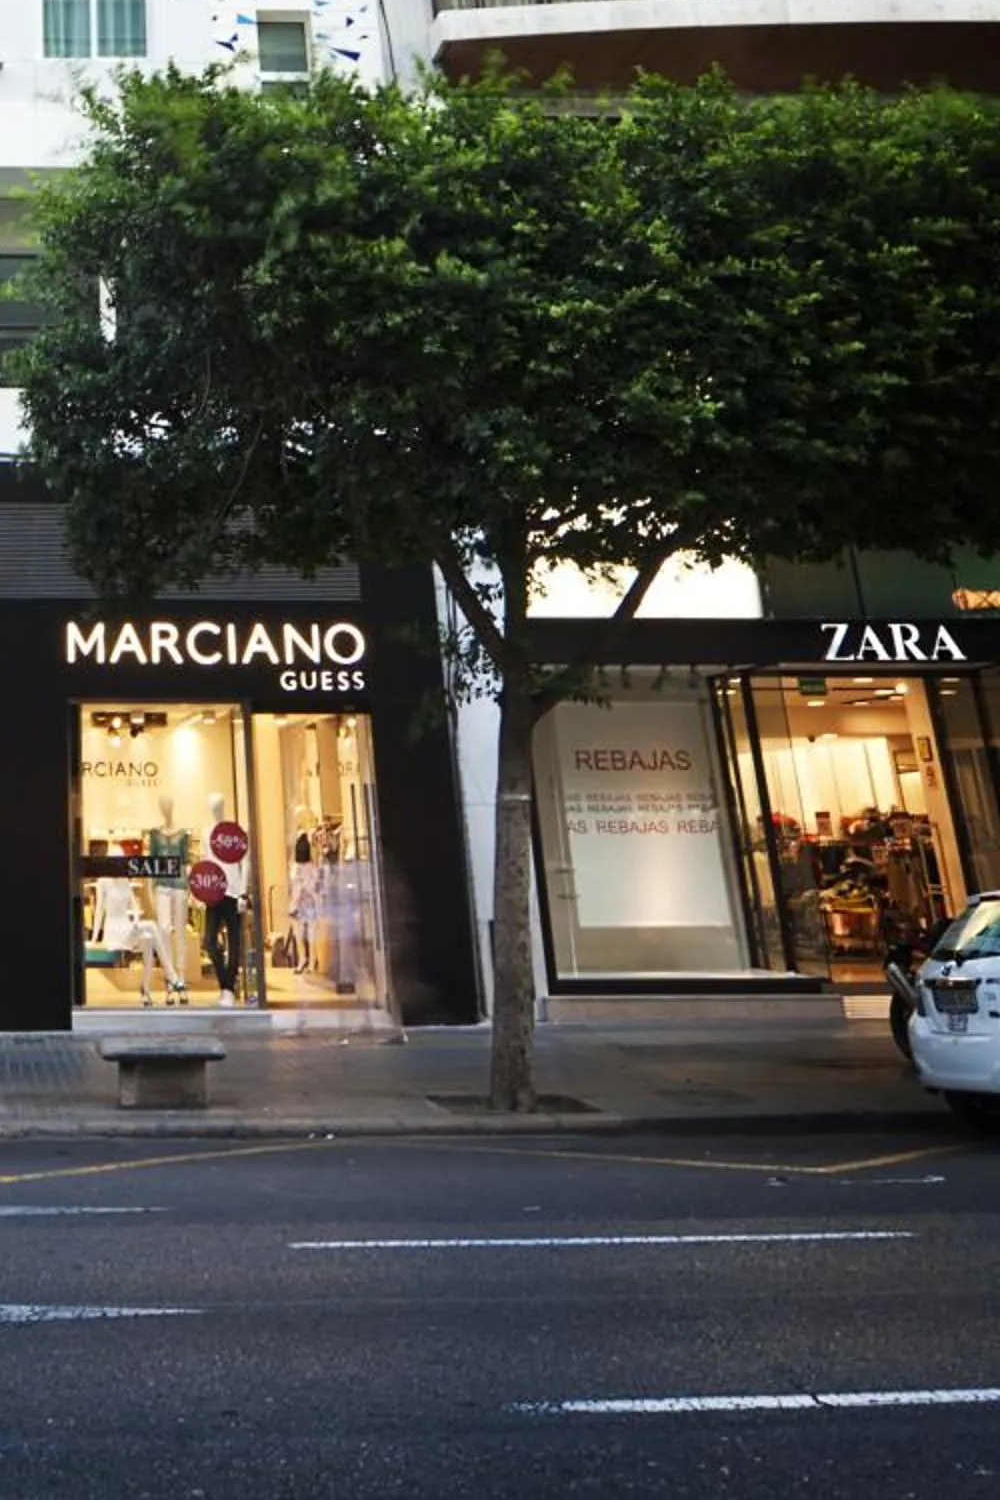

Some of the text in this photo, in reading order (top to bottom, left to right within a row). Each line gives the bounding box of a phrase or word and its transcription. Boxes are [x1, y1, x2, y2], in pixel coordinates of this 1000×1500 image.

[65, 621, 366, 666] MARCIANO
[820, 623, 968, 661] ZARA
[279, 670, 366, 692] GUESS
[574, 749, 693, 772] REBAJAS
[596, 819, 669, 835] REBAJAS
[127, 858, 179, 876] SALE
